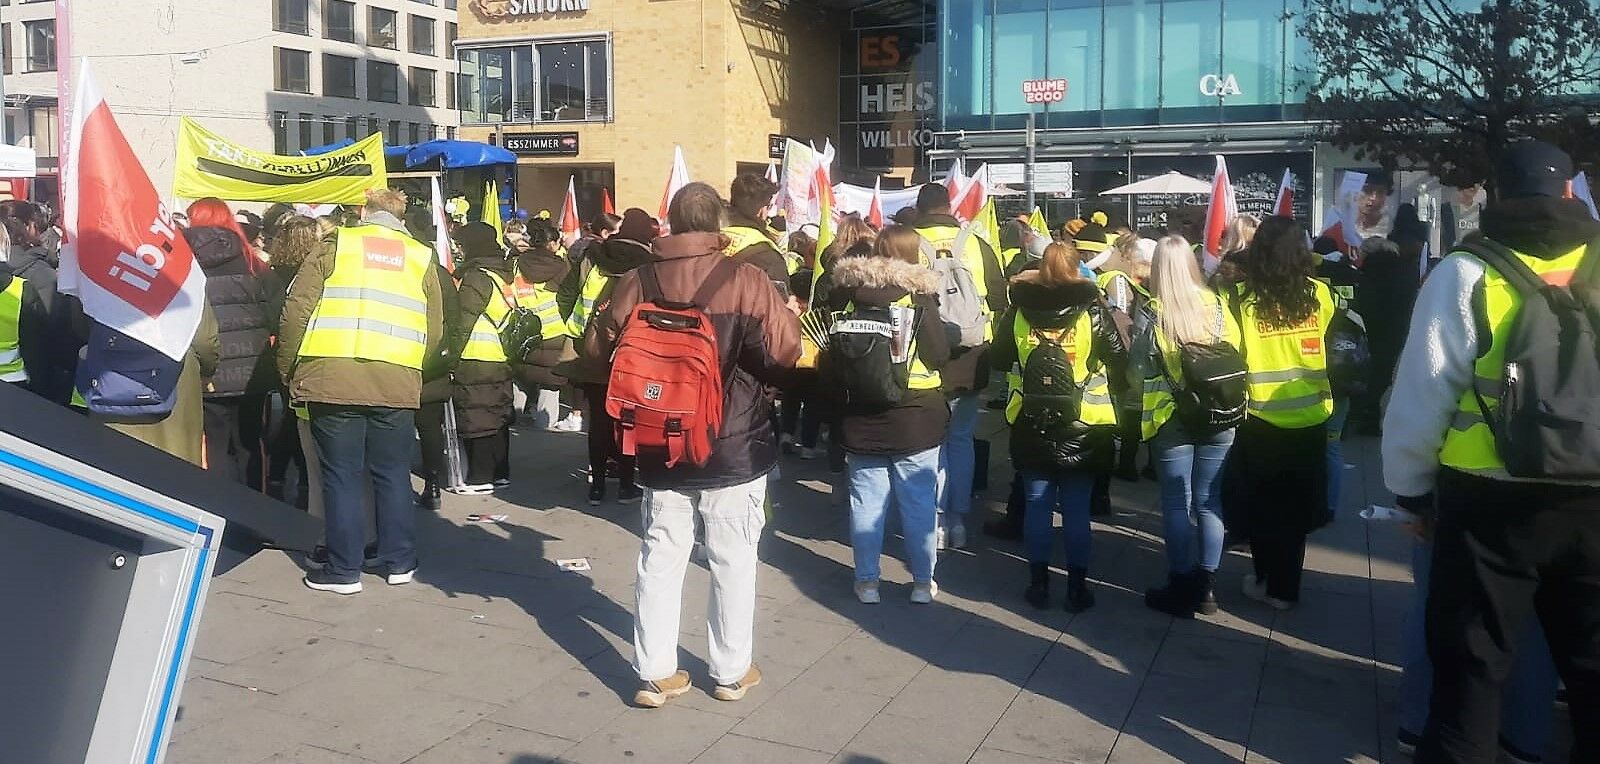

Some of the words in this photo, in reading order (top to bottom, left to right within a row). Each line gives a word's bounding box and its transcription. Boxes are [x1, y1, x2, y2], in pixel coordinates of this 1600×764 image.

[862, 36, 900, 67] ES
[1023, 80, 1065, 92] BLUME
[861, 82, 935, 113] HEIS
[1026, 91, 1063, 102] 2000
[508, 139, 559, 149] ESSZIMMER
[1249, 202, 1272, 211] MEHR
[366, 252, 403, 268] ver.di
